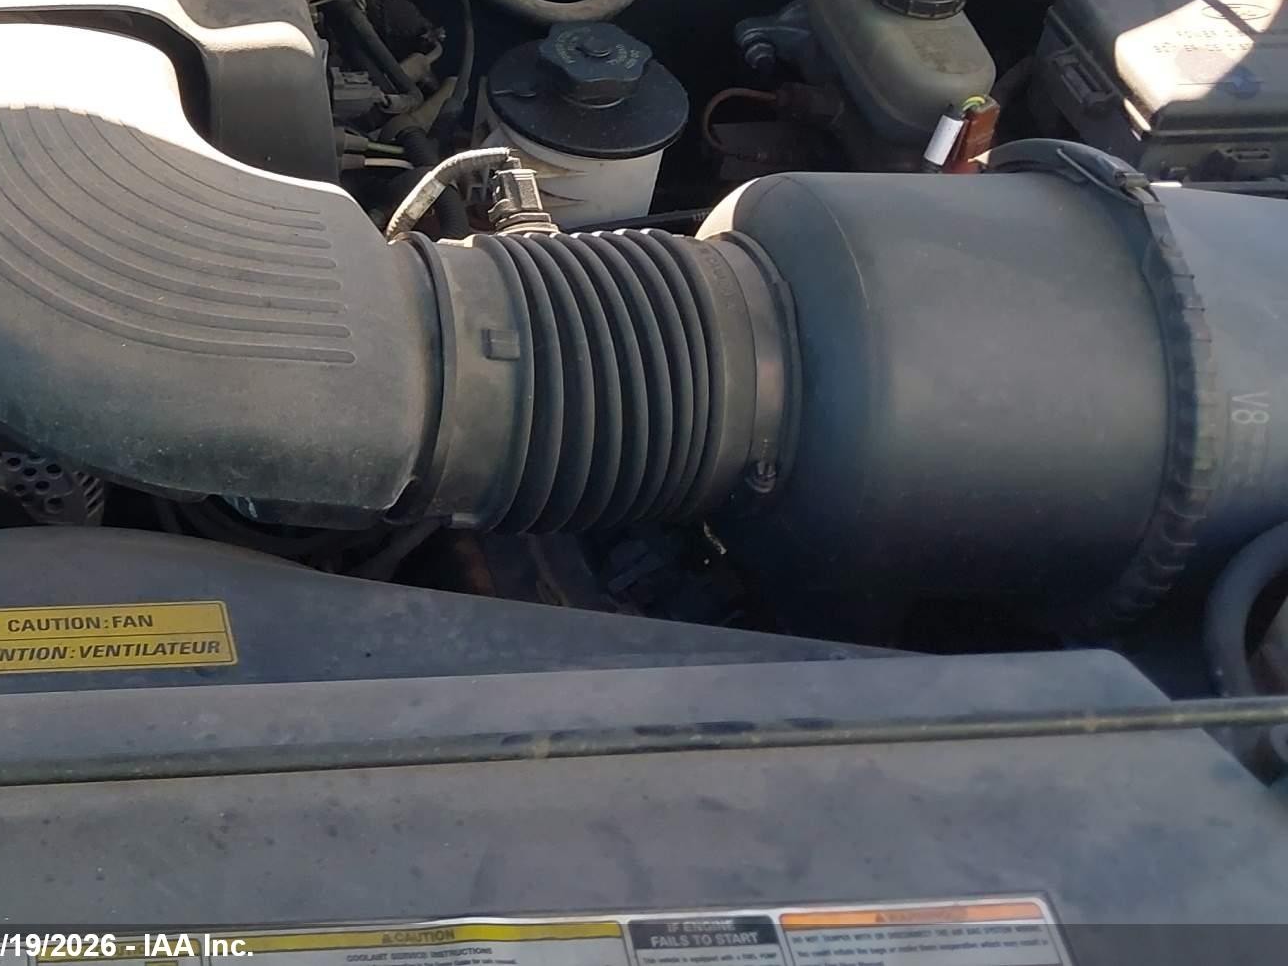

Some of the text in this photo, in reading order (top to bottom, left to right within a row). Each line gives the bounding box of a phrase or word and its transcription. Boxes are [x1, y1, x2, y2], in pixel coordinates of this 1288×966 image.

[1230, 391, 1270, 425] V8
[112, 614, 154, 629] FAN
[79, 640, 221, 659] VENTILATEUR
[683, 919, 736, 932] ENGINE
[394, 928, 456, 943] CAUTION
[650, 932, 759, 948] FAILS TO START
